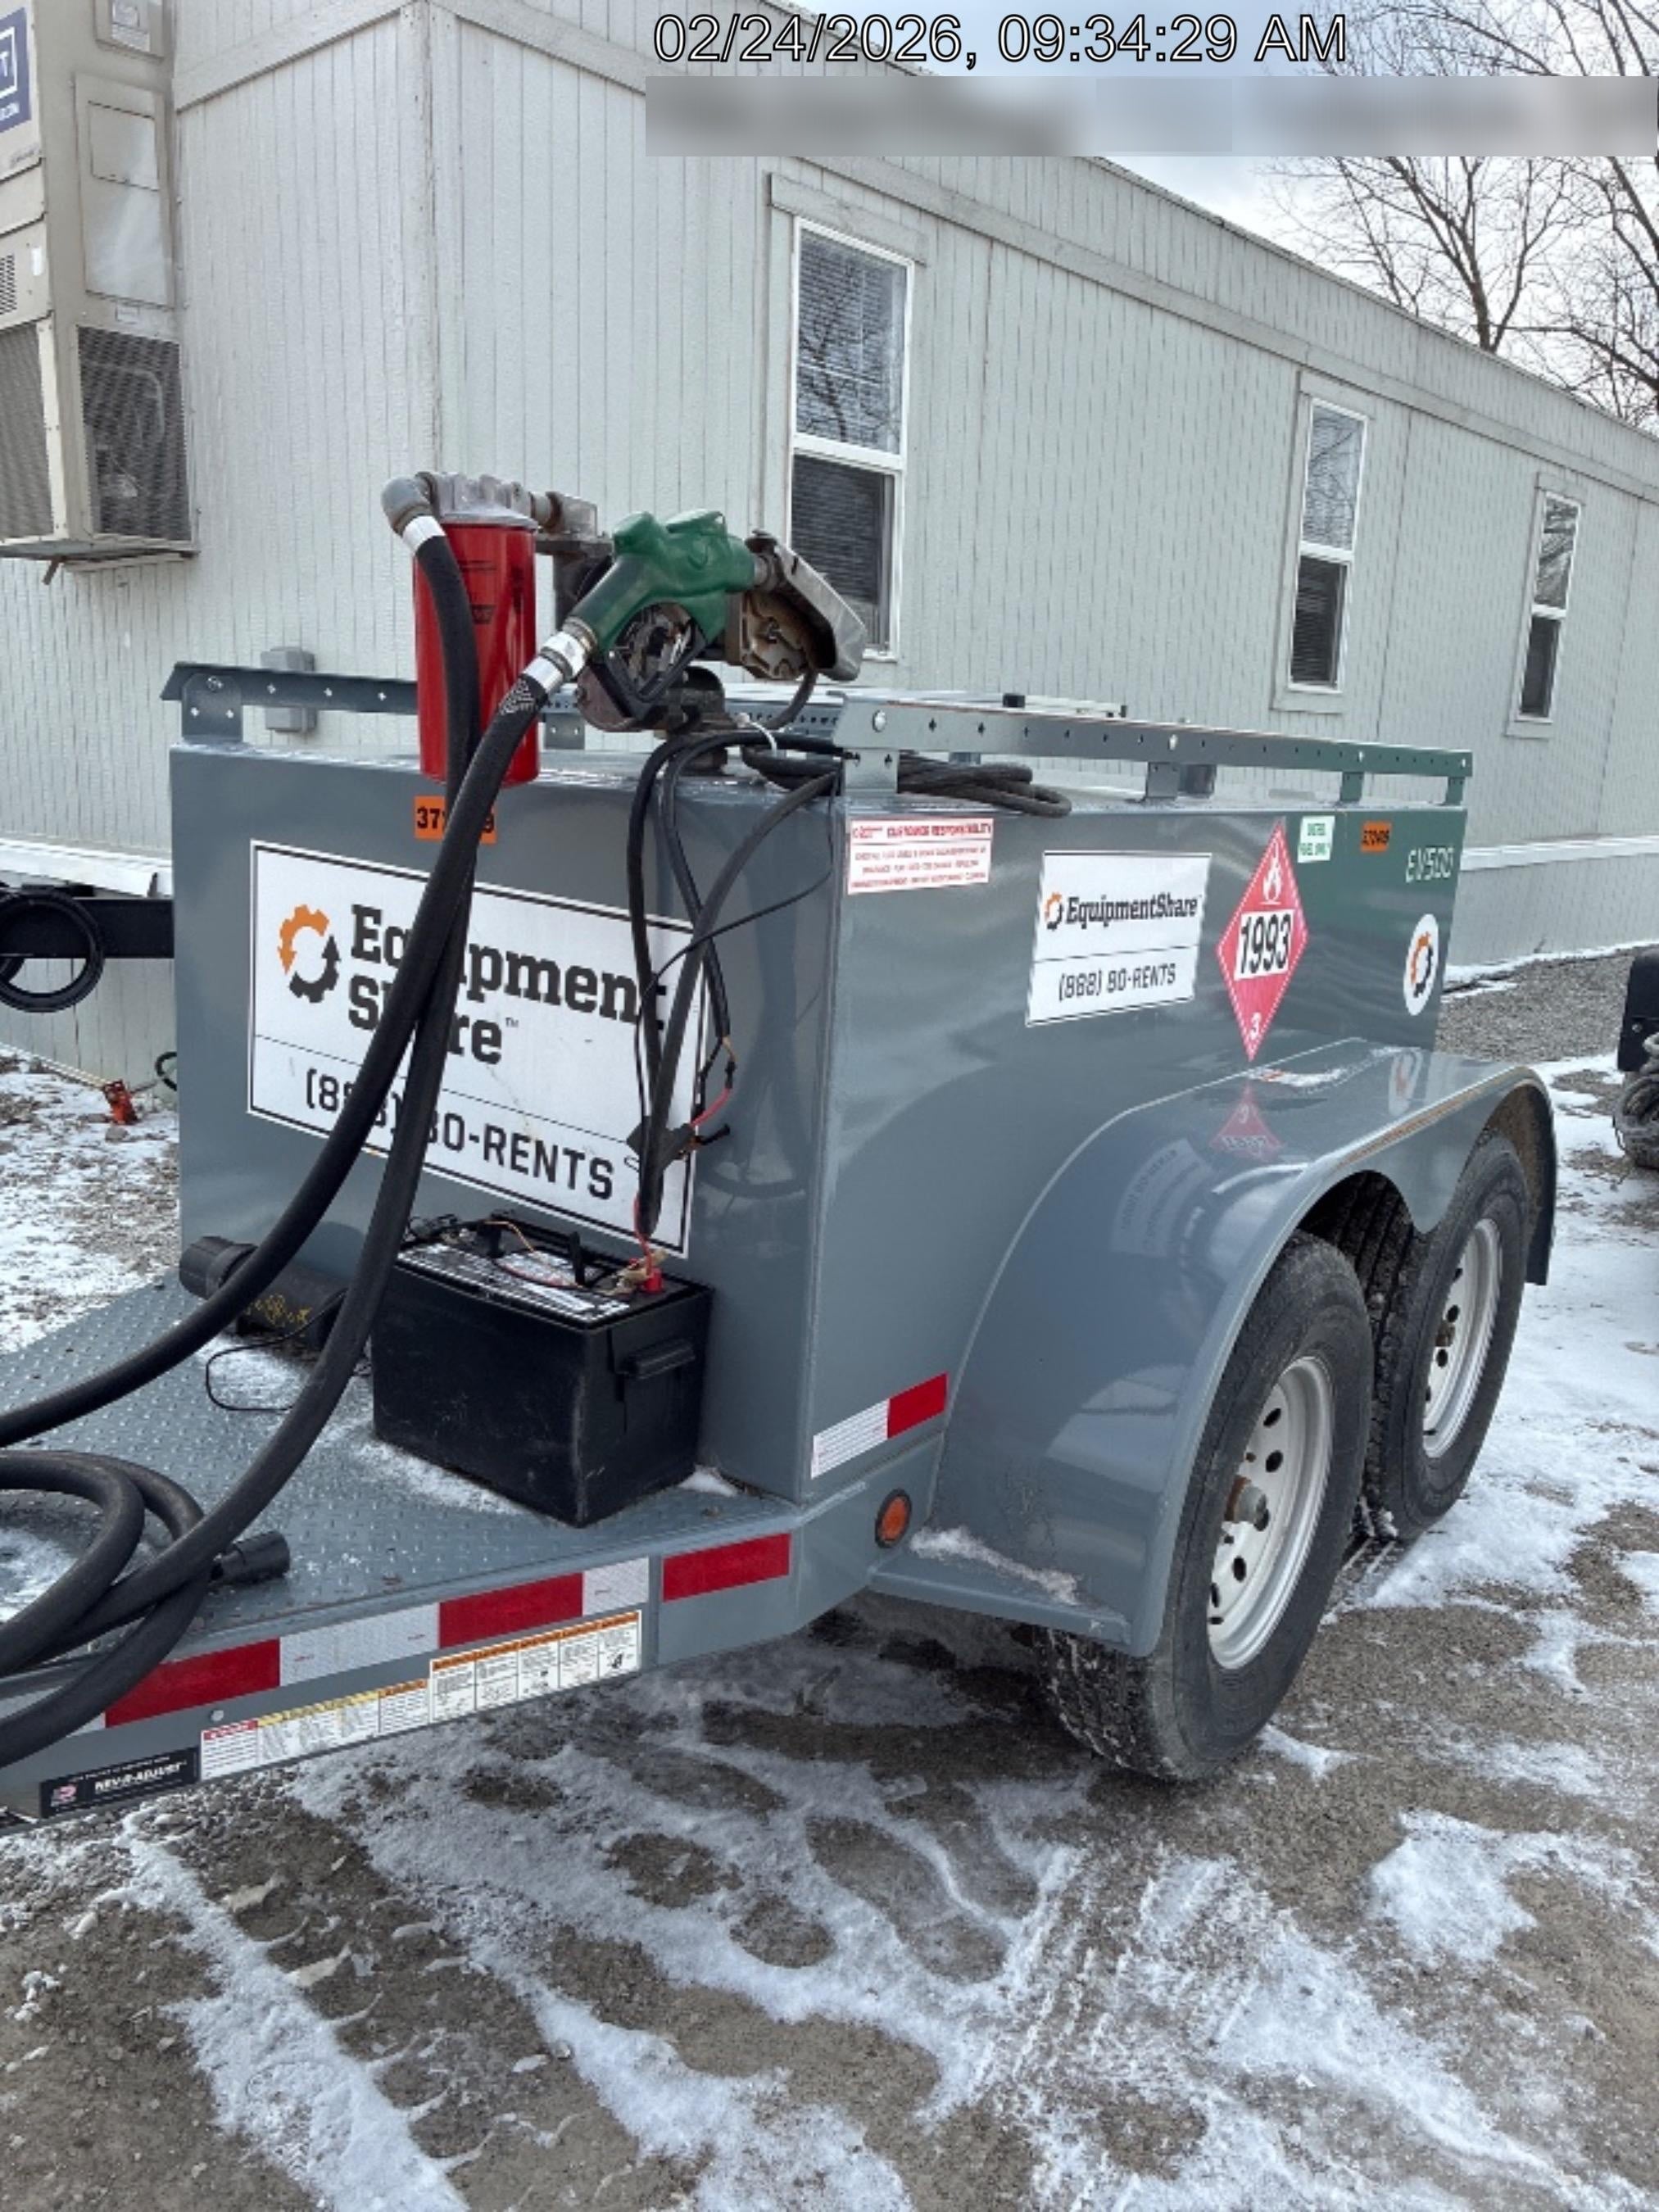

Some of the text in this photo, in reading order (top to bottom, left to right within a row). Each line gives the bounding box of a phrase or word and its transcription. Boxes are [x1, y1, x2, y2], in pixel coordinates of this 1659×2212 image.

[1066, 892, 1199, 930] EquipmentShare
[1240, 913, 1292, 975] 1993
[348, 973, 502, 1065] Sre
[1249, 1011, 1262, 1040] 3
